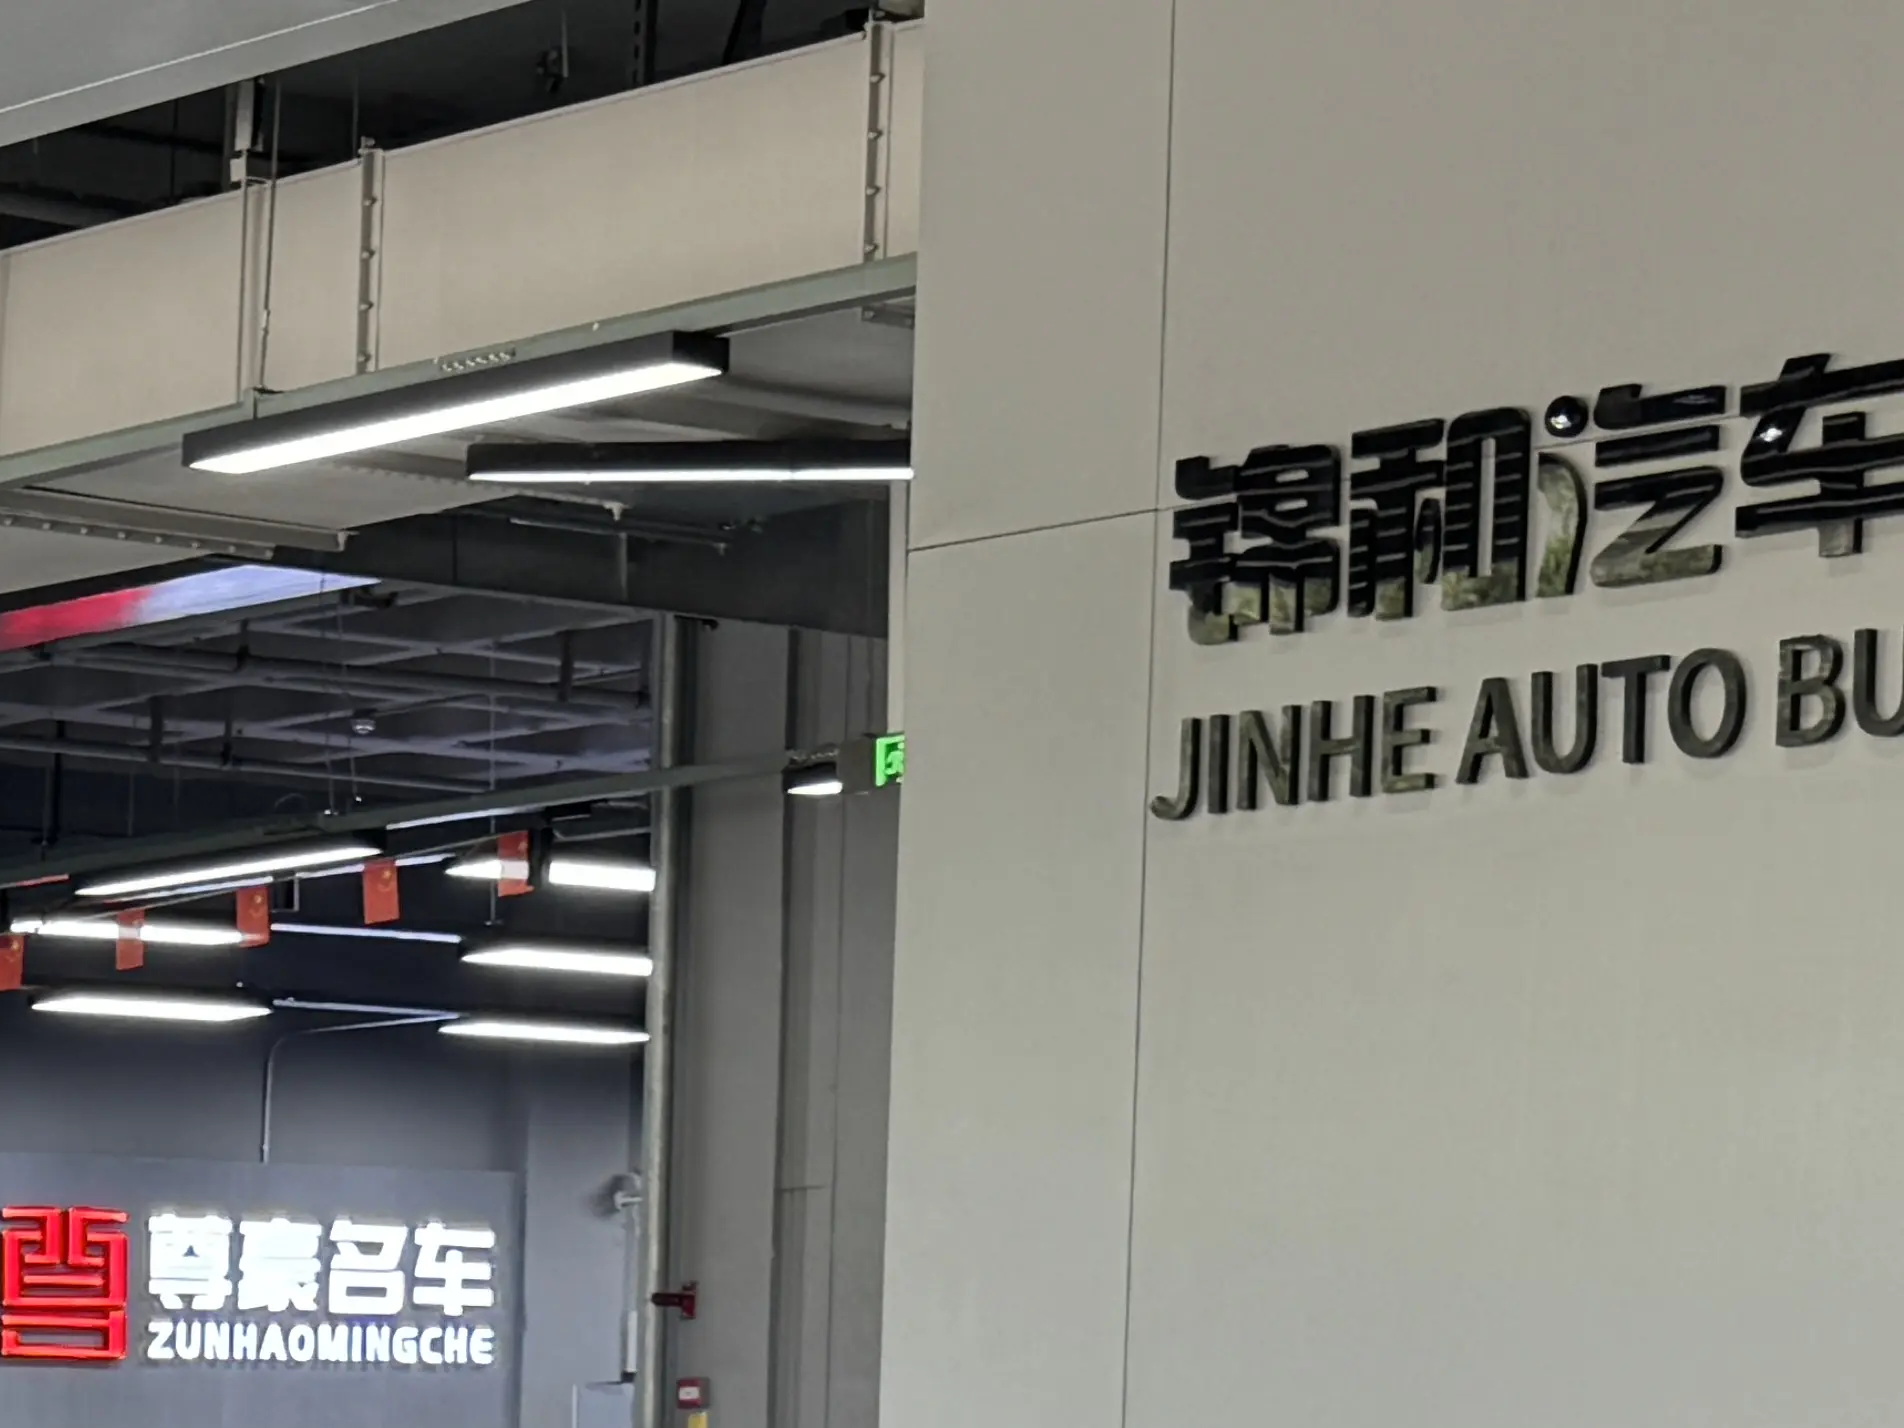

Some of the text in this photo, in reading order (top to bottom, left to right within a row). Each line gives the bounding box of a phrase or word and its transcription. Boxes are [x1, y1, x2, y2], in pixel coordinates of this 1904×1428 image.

[1170, 353, 1904, 645] 锦和汽车
[1150, 686, 1438, 821] JINHE
[1456, 648, 1748, 785] AUTO
[146, 1213, 496, 1317] 尊豪名车
[146, 1320, 496, 1365] ZUNHAOMINGCHE
